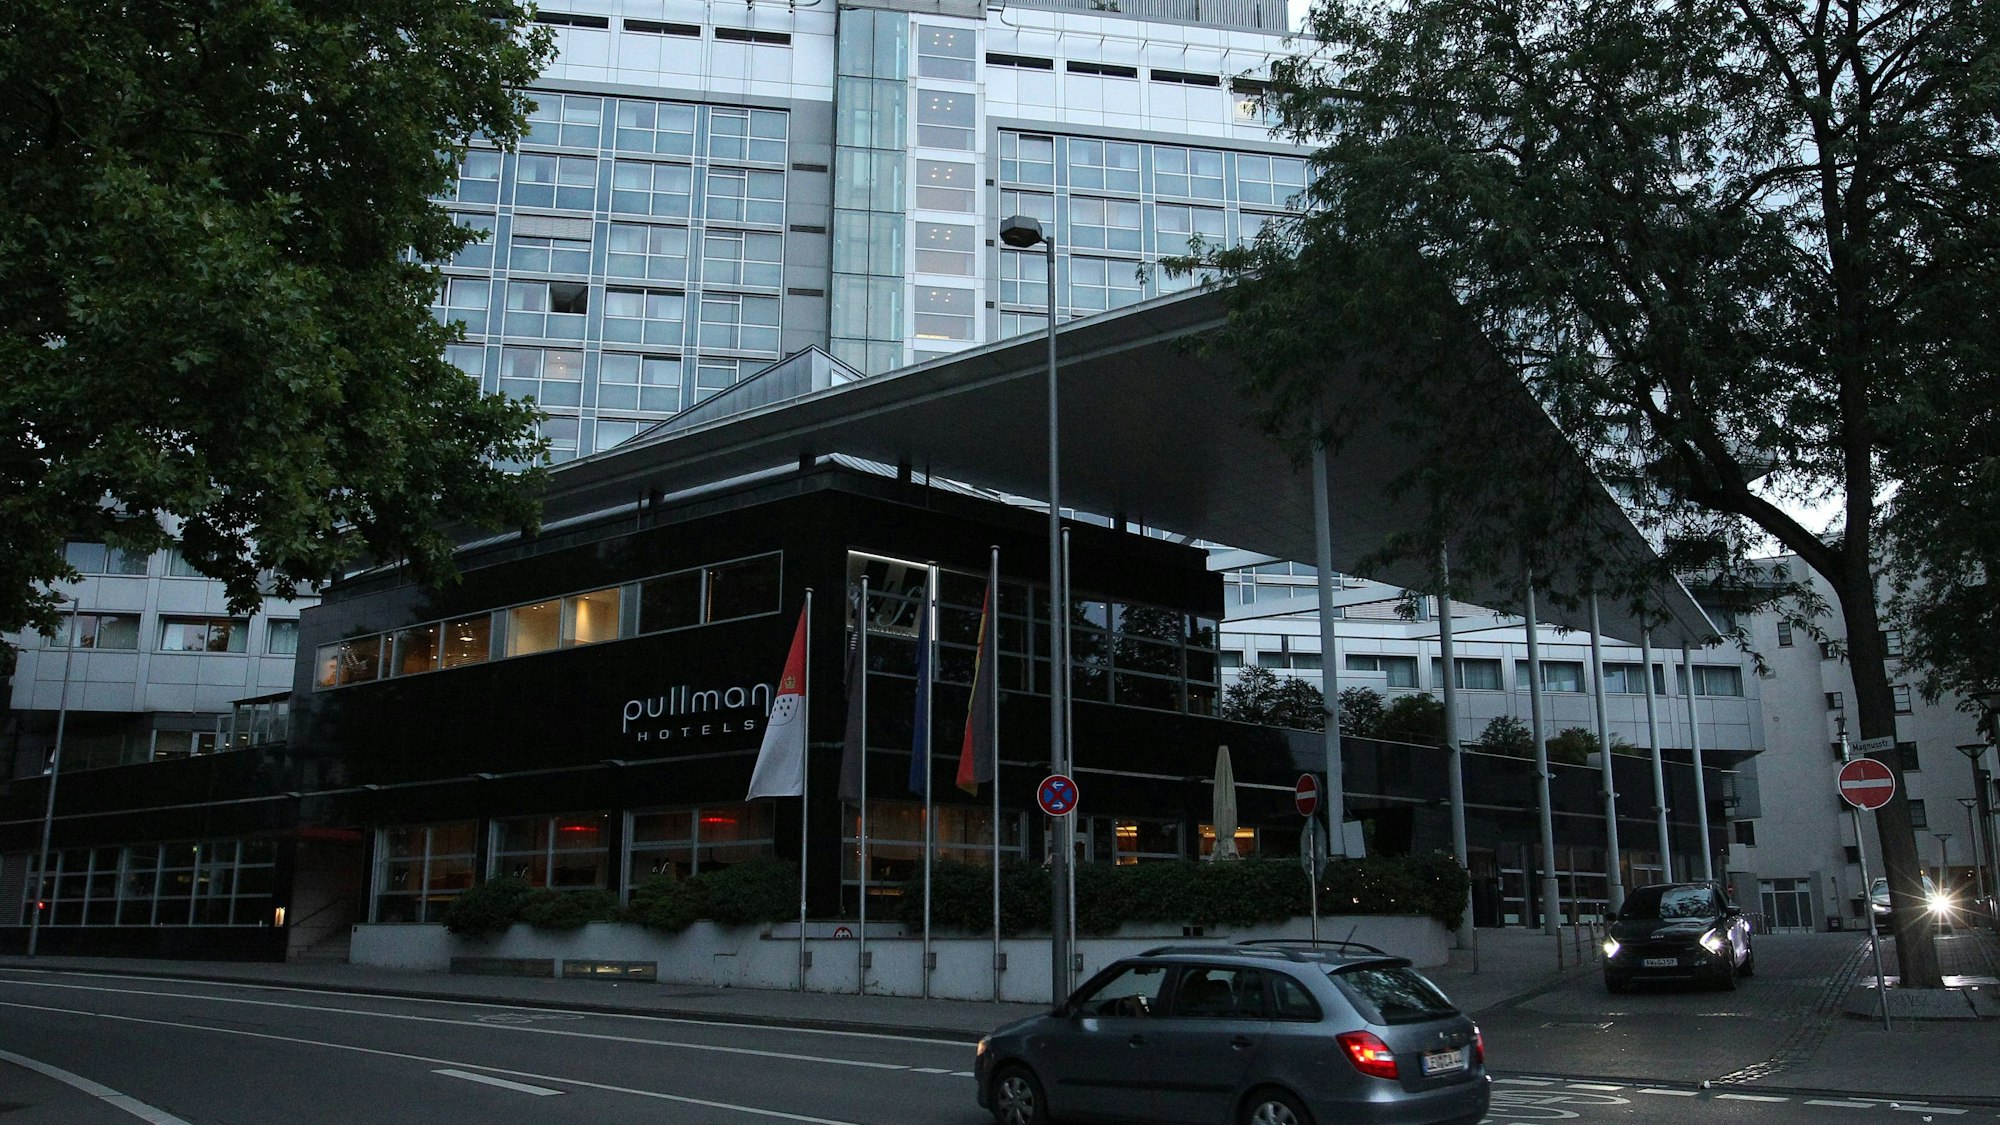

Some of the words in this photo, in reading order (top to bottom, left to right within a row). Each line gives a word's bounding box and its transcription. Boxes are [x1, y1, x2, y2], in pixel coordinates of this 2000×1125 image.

[622, 683, 770, 734] pullman
[637, 719, 755, 742] HOTELS
[1852, 740, 1890, 752] Magnusstr.
